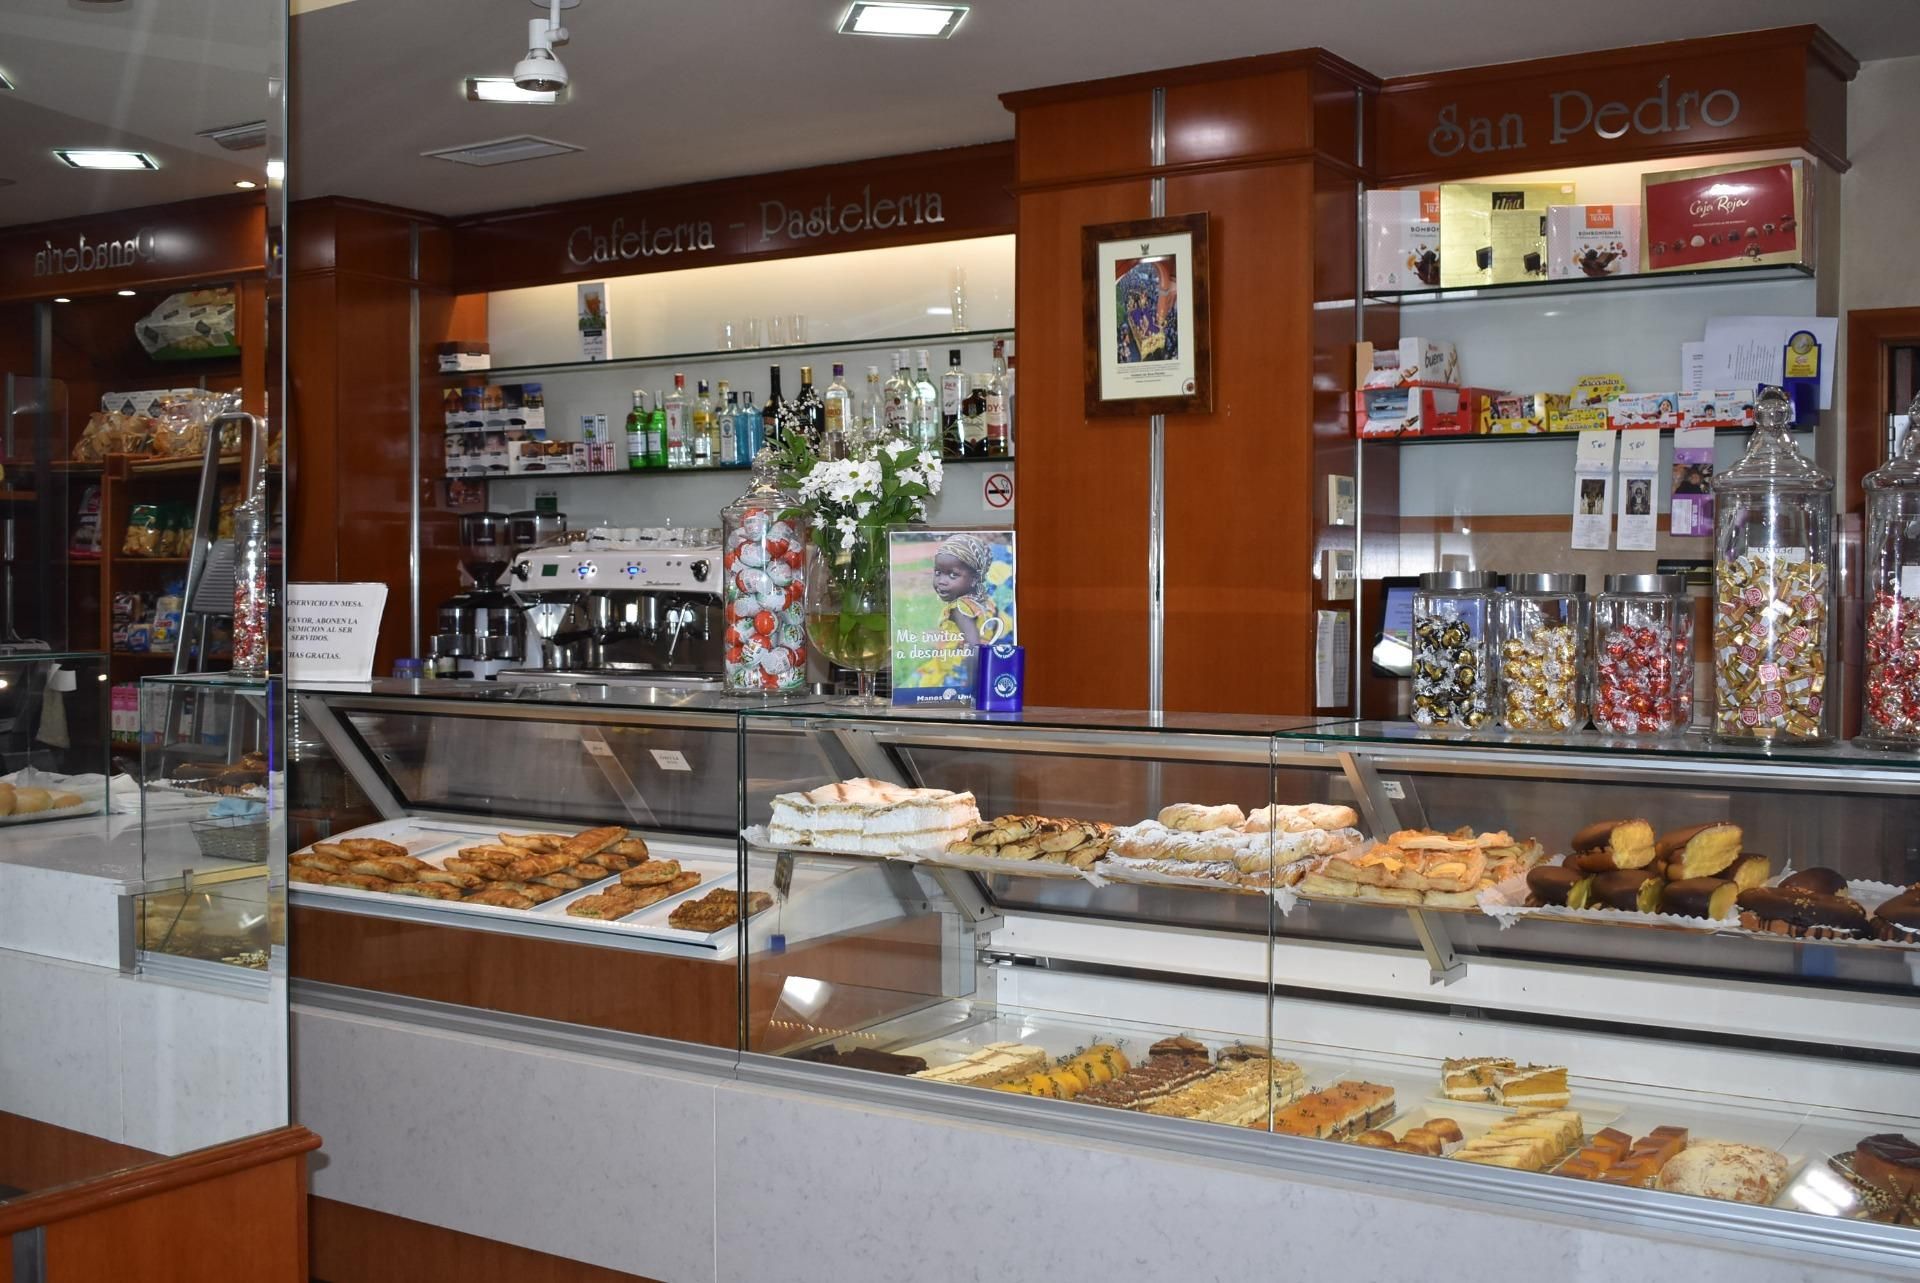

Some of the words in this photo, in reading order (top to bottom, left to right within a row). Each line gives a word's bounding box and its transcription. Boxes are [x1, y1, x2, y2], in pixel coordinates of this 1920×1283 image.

[1428, 103, 1527, 158] San
[1550, 73, 1741, 145] Pedro
[1689, 200, 1714, 218] Caja
[1716, 194, 1750, 215] Roja
[337, 626, 353, 634] SER
[896, 629, 917, 643] Me
[922, 631, 965, 642] invitas
[896, 649, 906, 660] a
